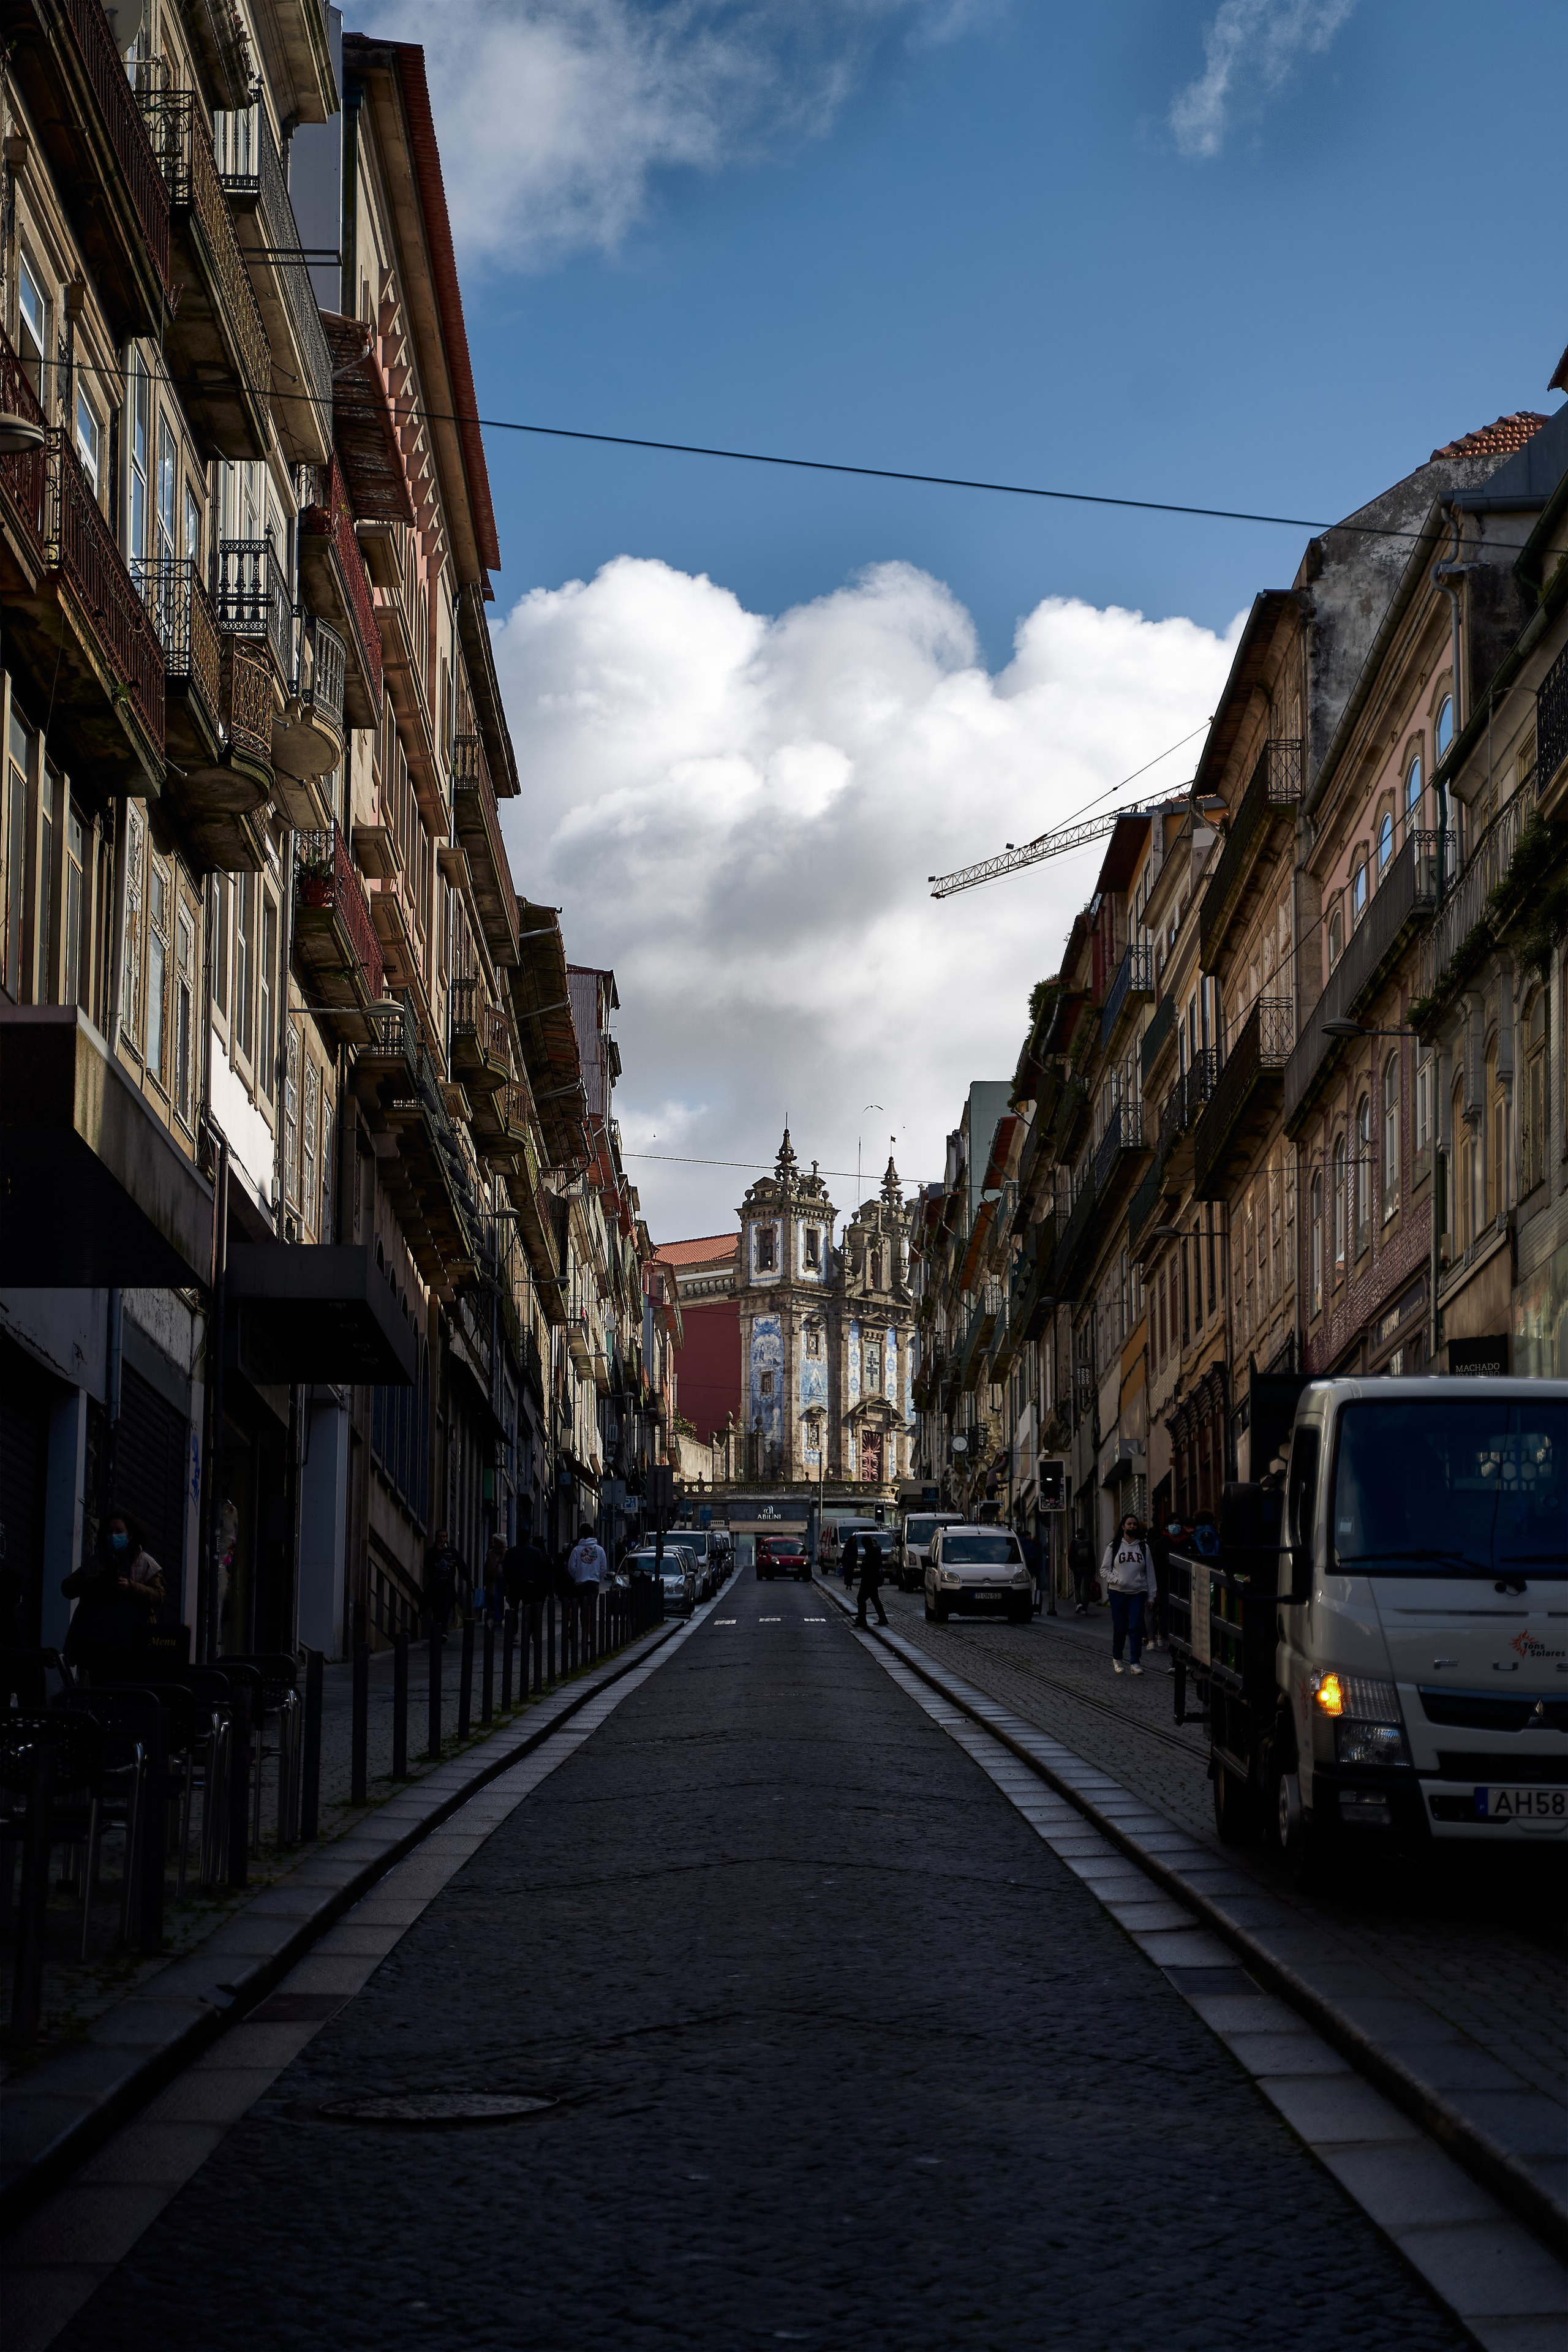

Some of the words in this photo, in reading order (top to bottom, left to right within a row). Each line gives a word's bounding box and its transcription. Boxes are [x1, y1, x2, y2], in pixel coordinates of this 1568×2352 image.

[1455, 1362, 1500, 1373] MACHADO
[625, 1498, 631, 1507] P
[1119, 1551, 1143, 1564] GAP
[148, 1637, 176, 1646] Menu
